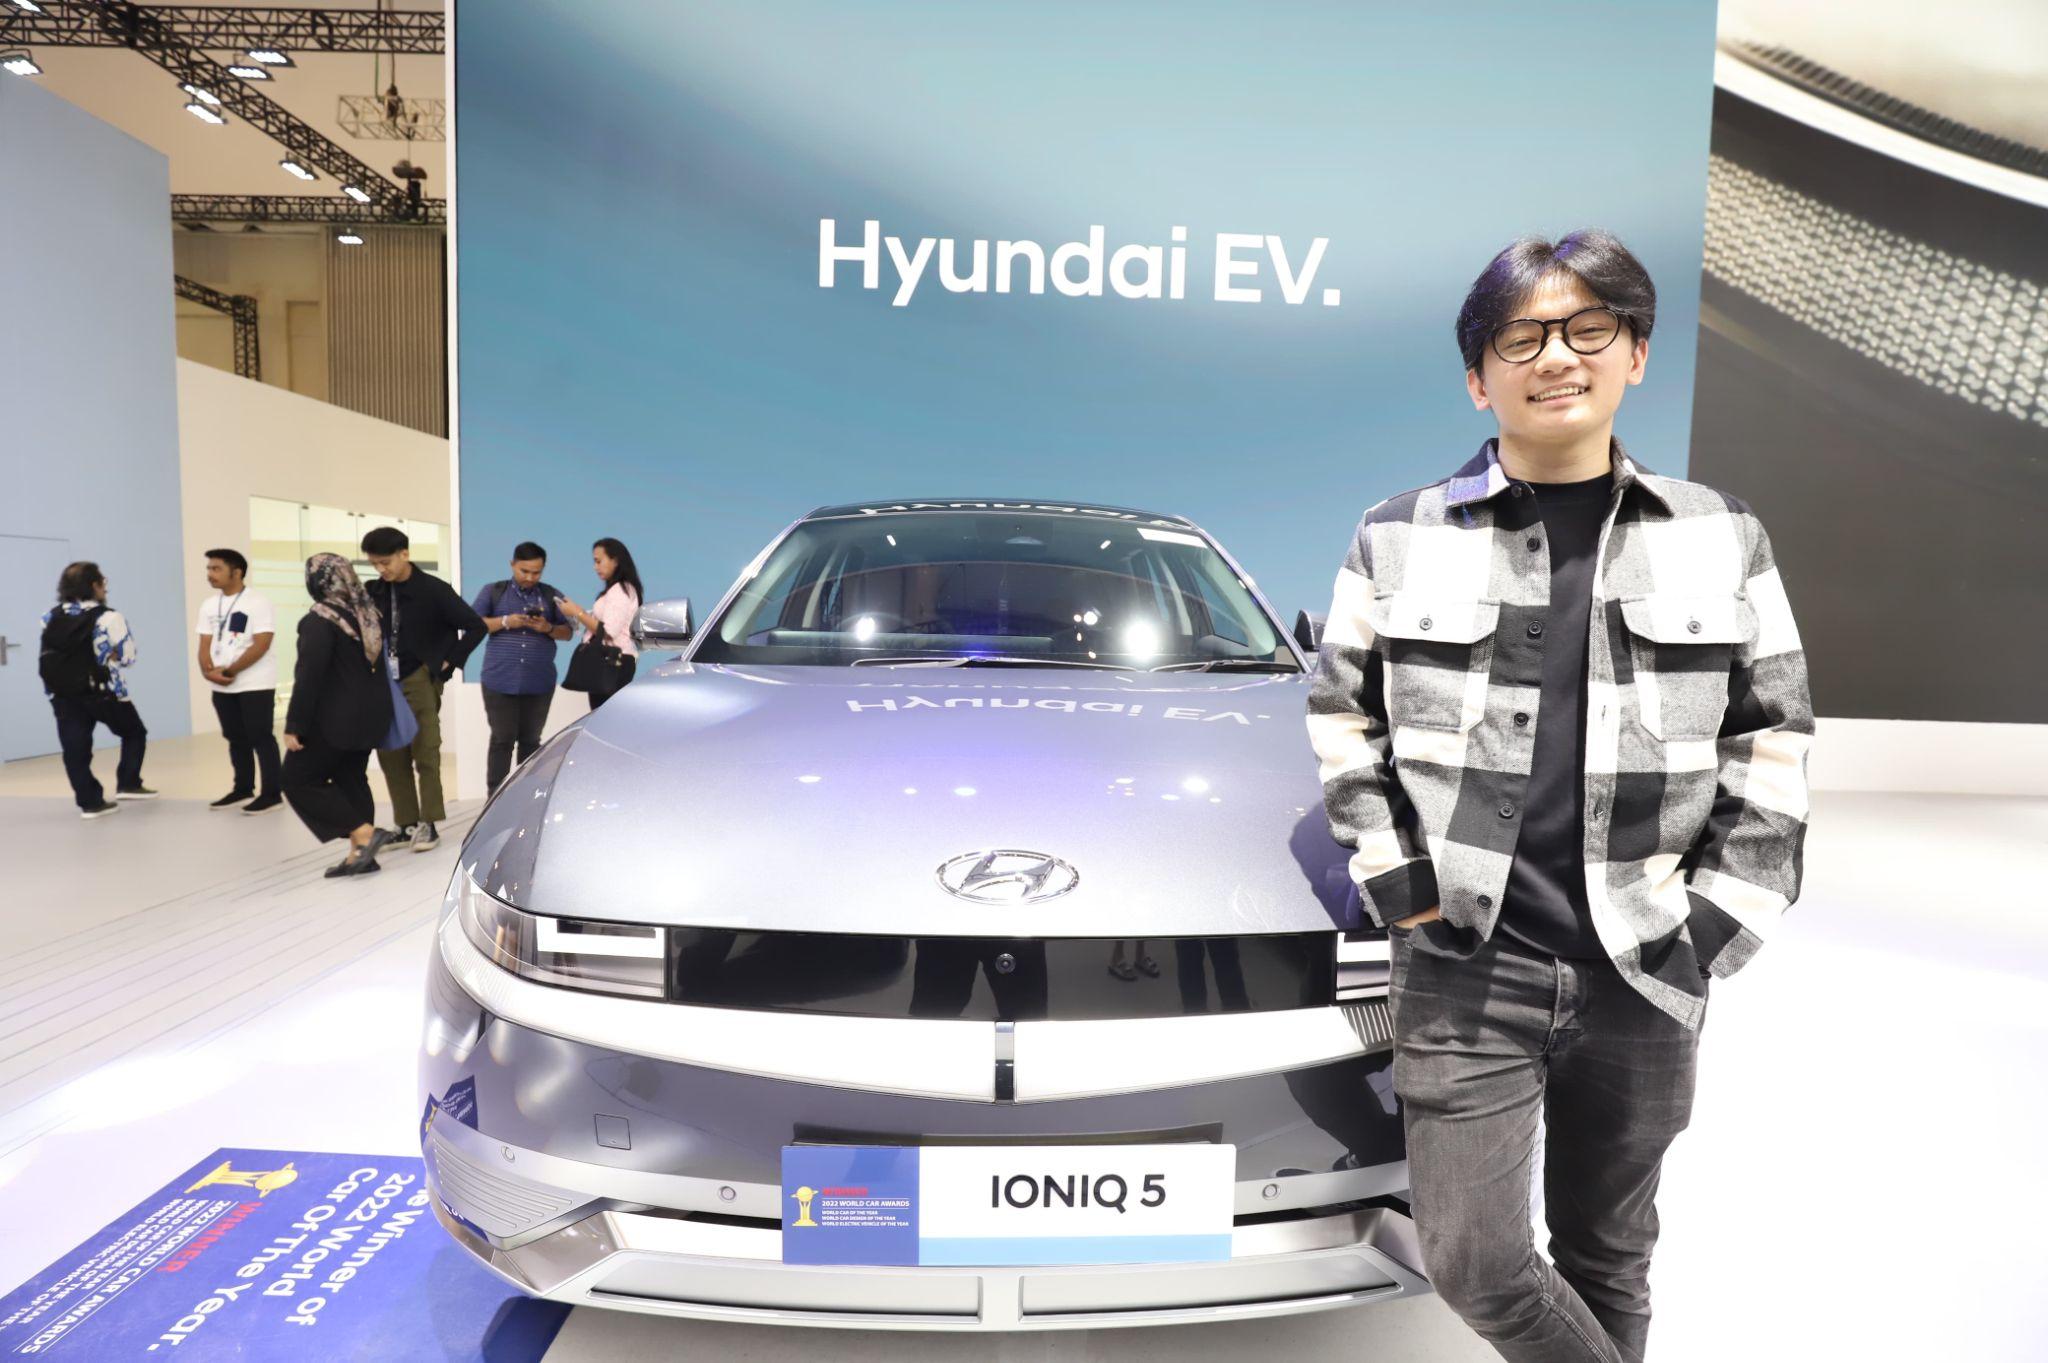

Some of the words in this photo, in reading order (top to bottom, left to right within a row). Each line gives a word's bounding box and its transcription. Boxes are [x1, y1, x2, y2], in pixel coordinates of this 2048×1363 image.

[819, 219, 1187, 306] Hyundai
[1214, 233, 1340, 306] EV.
[326, 1168, 378, 1203] Car
[345, 1173, 415, 1222] 2022
[992, 1174, 1127, 1213] IONIQ
[1140, 1174, 1166, 1207] 5
[192, 1201, 231, 1225] 2022
[292, 1205, 336, 1231] Of
[139, 1225, 200, 1266] WORLD
[236, 1234, 308, 1277] The
[262, 1225, 363, 1296] World
[320, 1210, 424, 1293] Winner
[102, 1268, 142, 1293] CAR
[18, 1300, 58, 1324] YEAR
[20, 1295, 105, 1353] AWARDS
[147, 1282, 253, 1351] Year.
[285, 1296, 326, 1325] of
